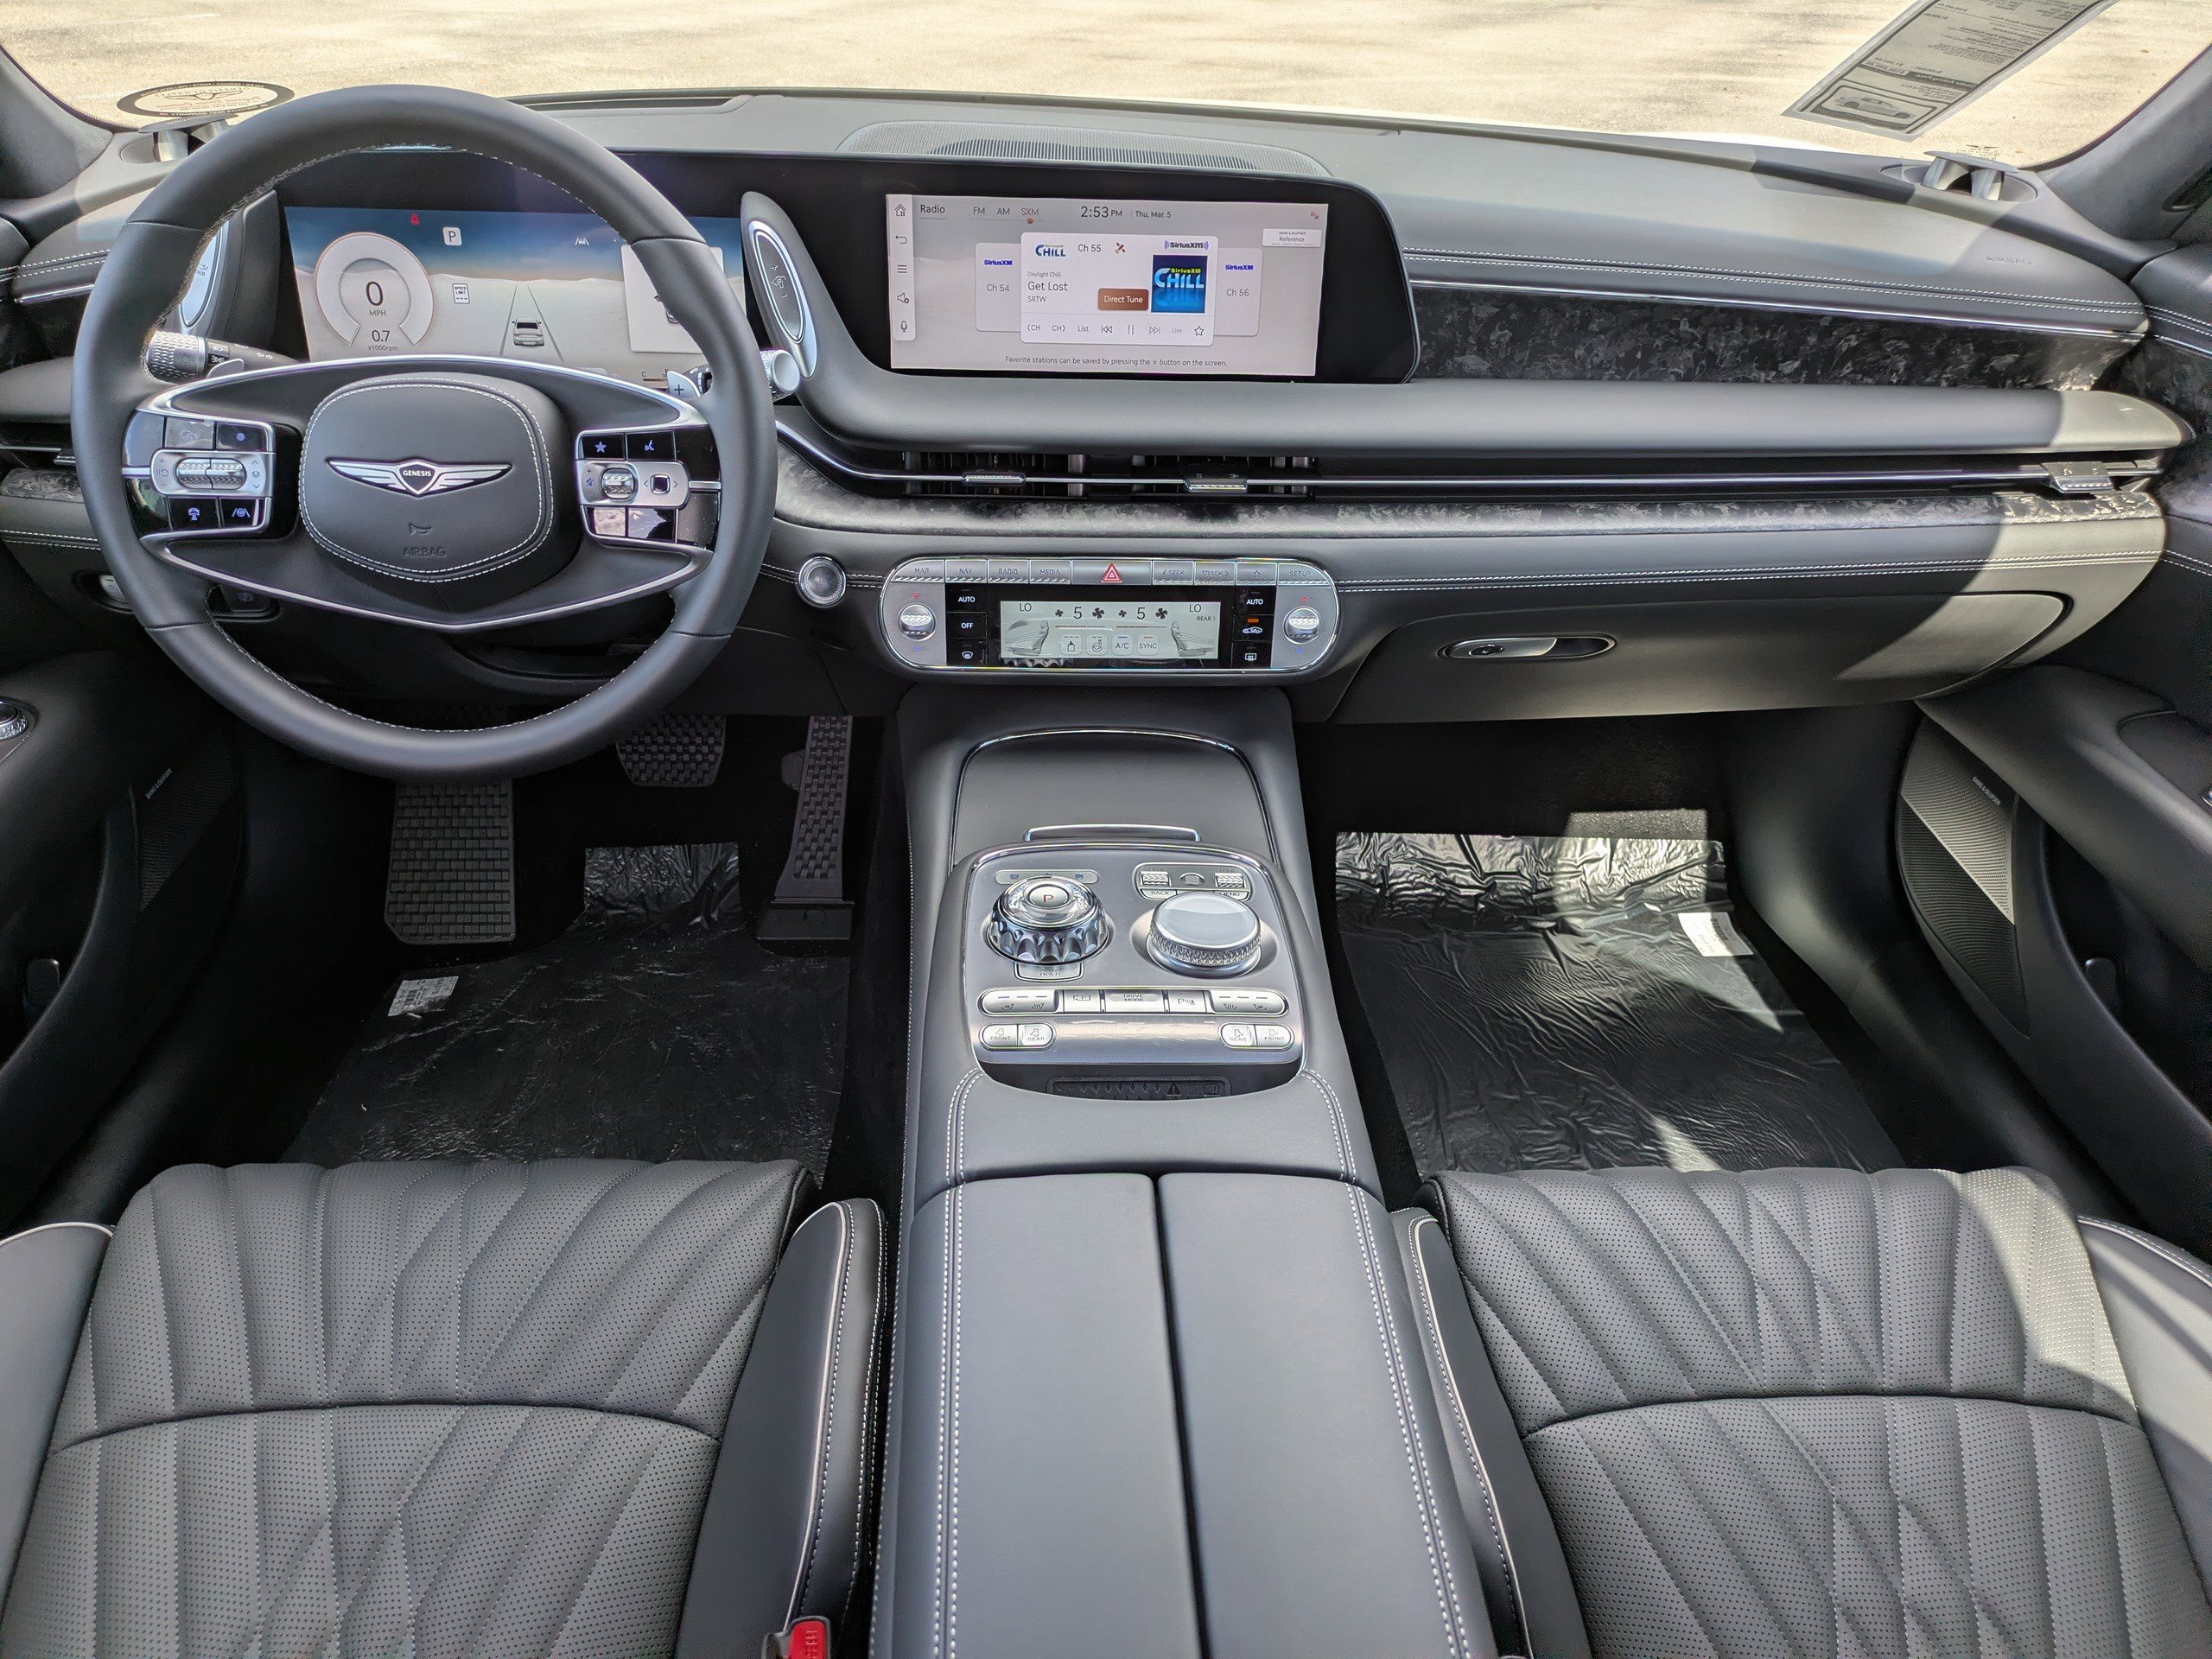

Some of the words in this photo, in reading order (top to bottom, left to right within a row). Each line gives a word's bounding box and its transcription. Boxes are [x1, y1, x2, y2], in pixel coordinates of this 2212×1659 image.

[919, 204, 945, 214] Radio
[1020, 207, 1039, 216] SXM
[1080, 206, 1109, 218] 2:53
[1111, 209, 1123, 218] PM
[448, 231, 456, 243] P
[1035, 244, 1065, 257] CHILL
[1077, 244, 1089, 252] Ch
[1091, 244, 1102, 252] 55
[1154, 267, 1205, 289] CHILL
[987, 283, 997, 292] Ch
[1027, 281, 1045, 291] Get
[1048, 282, 1068, 292] Lost
[365, 281, 384, 307] 0
[1103, 295, 1124, 303] Direct
[372, 329, 391, 342] 0.7
[1005, 355, 1030, 364] Favorite
[1102, 358, 1110, 366] by
[1111, 359, 1138, 367] pressing
[404, 546, 448, 558] AIRBAG
[1019, 603, 1033, 613] LO
[1073, 606, 1083, 620] 5
[1136, 607, 1146, 620] 5
[1189, 603, 1202, 613] LO
[1042, 894, 1054, 904] P
